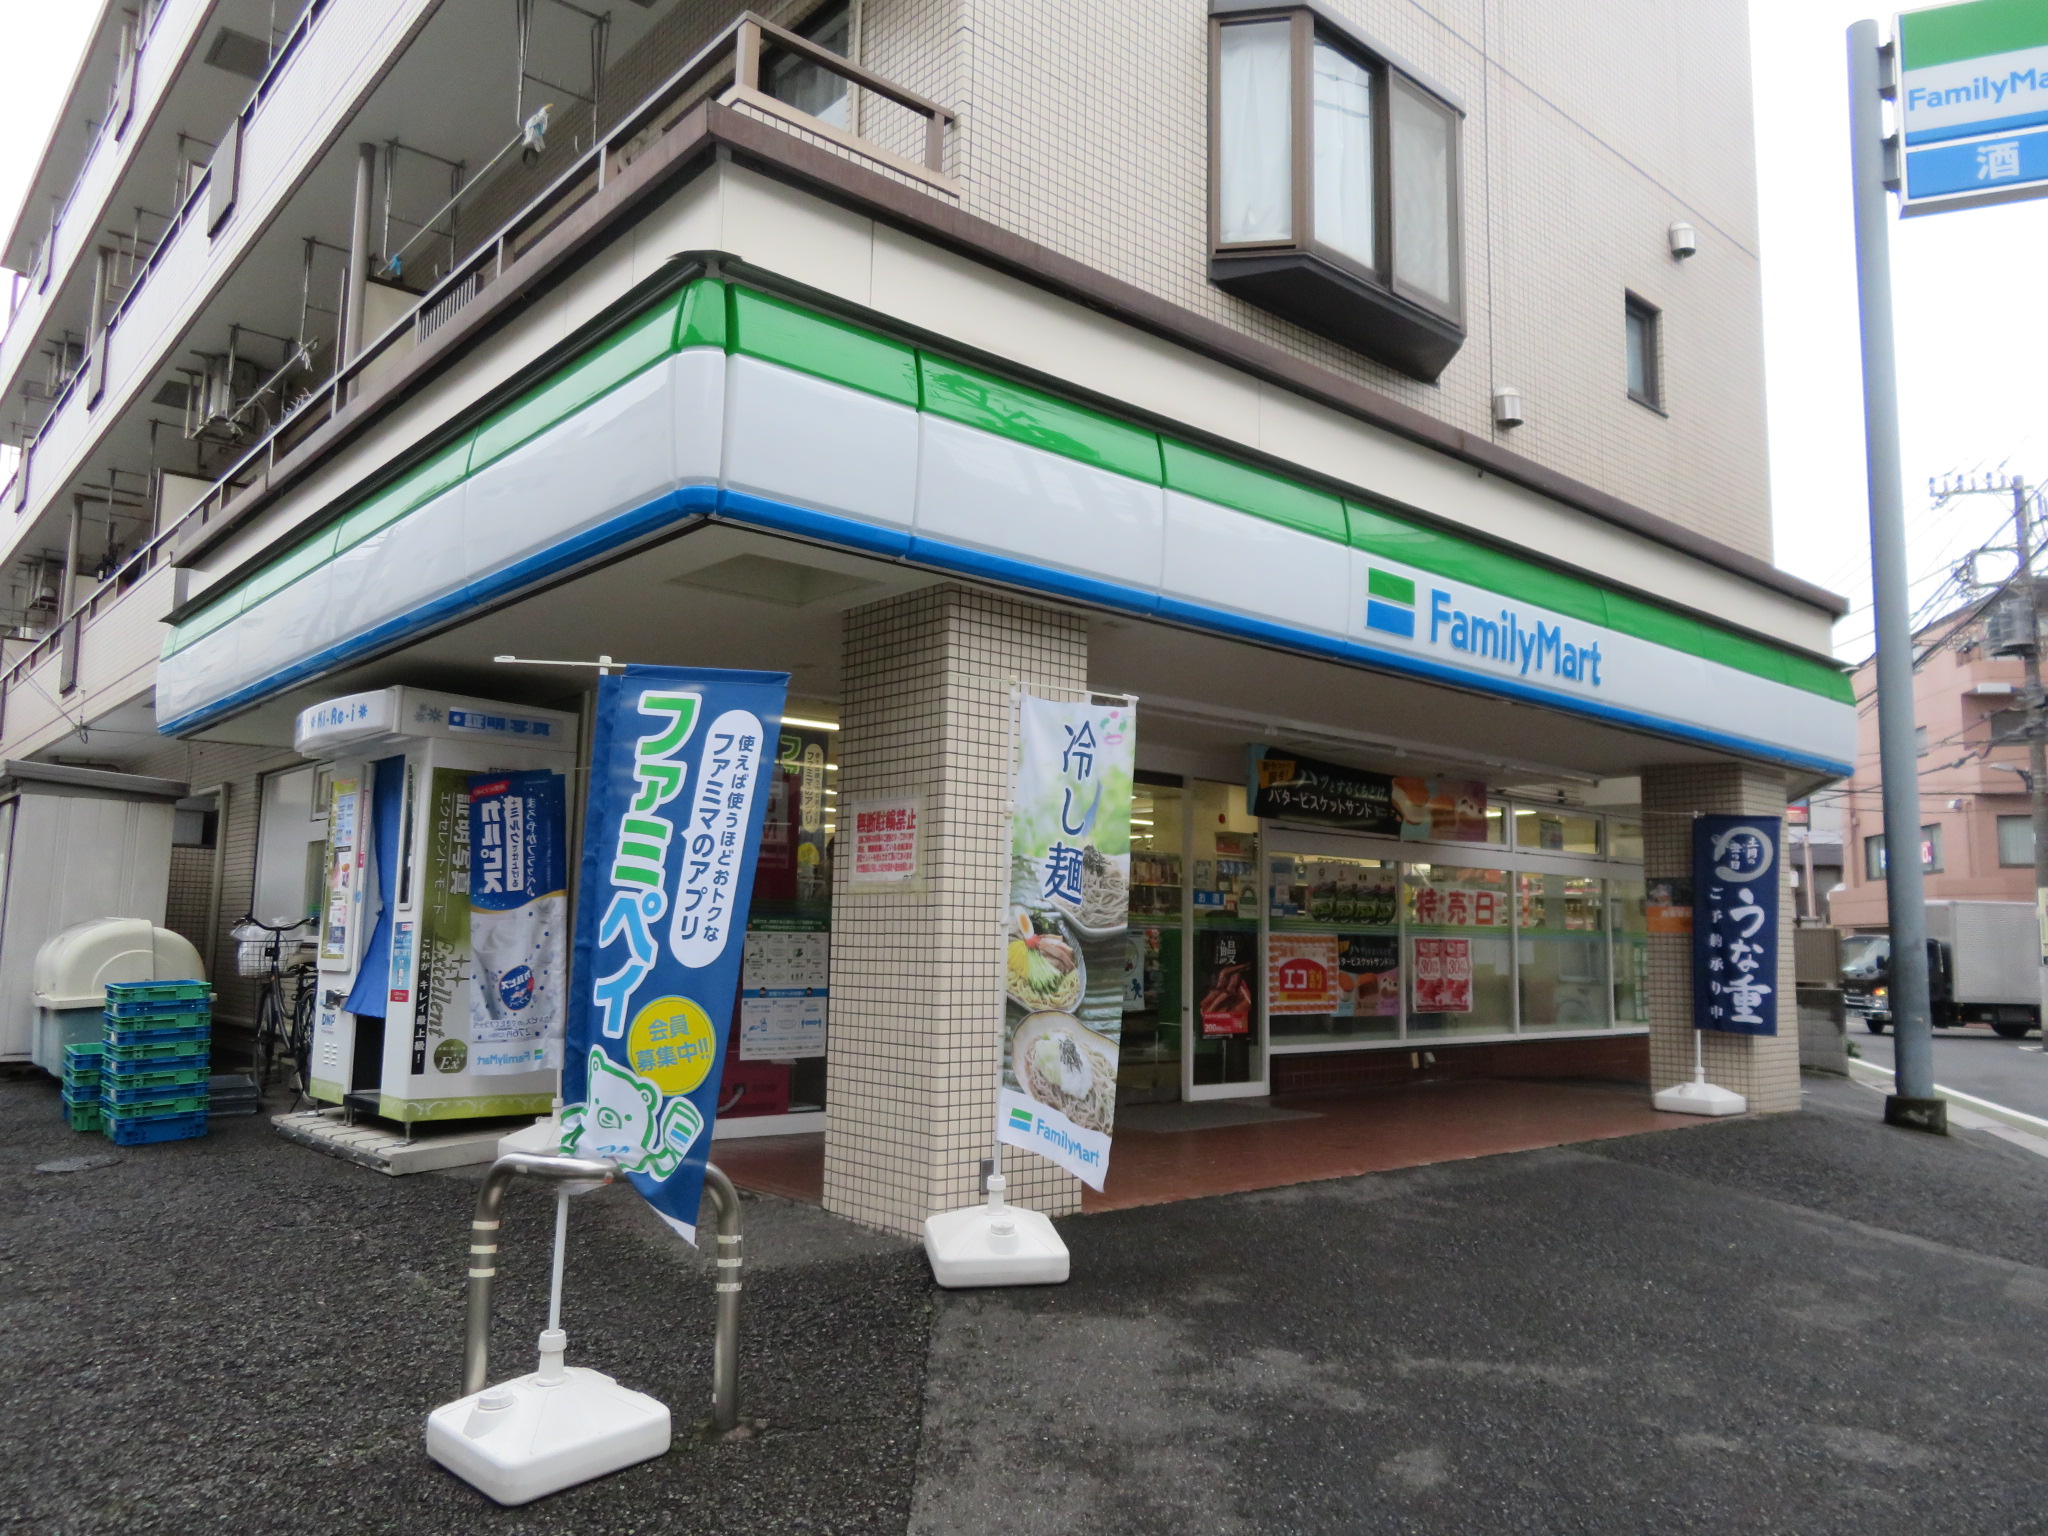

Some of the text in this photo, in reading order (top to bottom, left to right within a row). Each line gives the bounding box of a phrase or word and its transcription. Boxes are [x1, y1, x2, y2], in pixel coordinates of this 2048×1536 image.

[1976, 141, 2020, 181] 酒
[1430, 588, 1602, 686] FamilyMart
[680, 732, 734, 941] ファミマのアプリ
[704, 734, 756, 942] 使えば使うほどおトクな
[1044, 719, 1098, 906] 冷し麺
[1268, 787, 1373, 818] バタービスケットサンド
[595, 692, 700, 1037] ファミペイ
[428, 932, 456, 1039] Excellent
[1722, 887, 1773, 1024] うな重
[647, 1013, 690, 1043] 会員
[1036, 1117, 1101, 1168] FamilyMart
